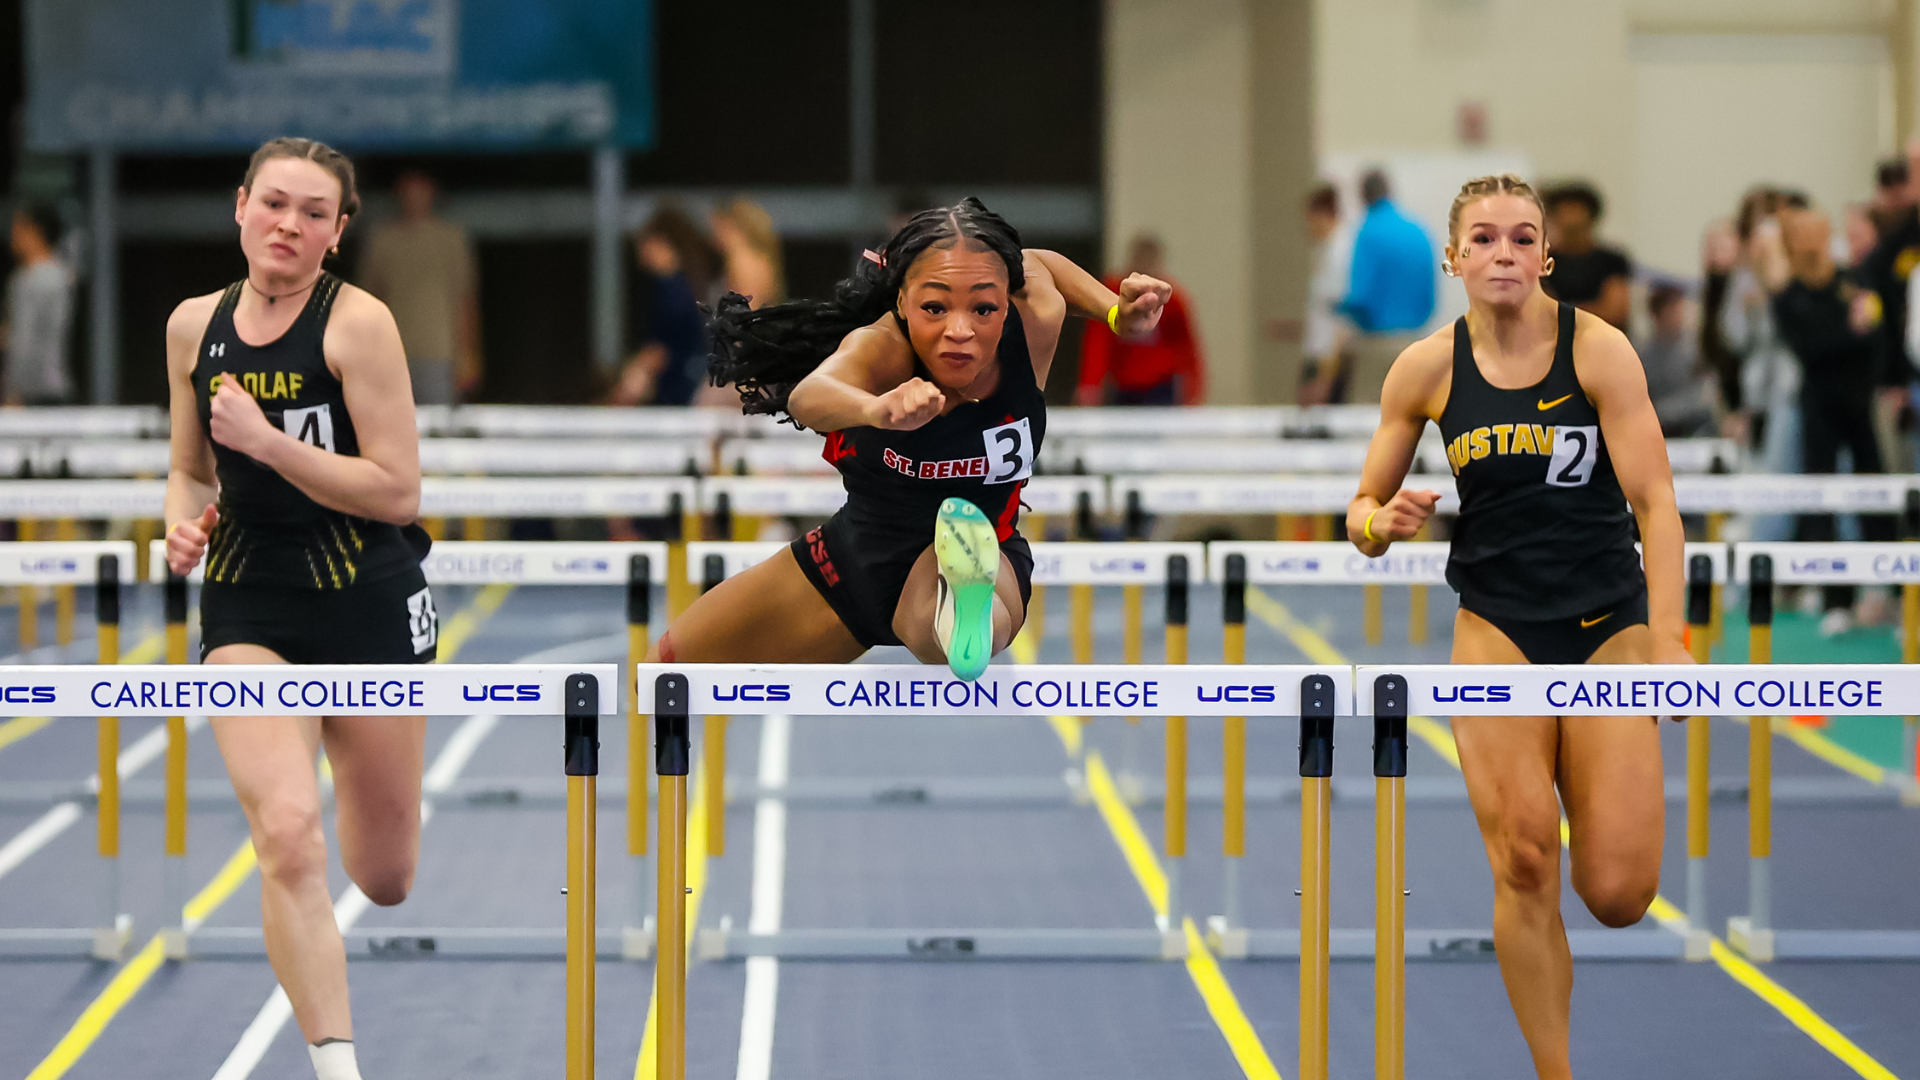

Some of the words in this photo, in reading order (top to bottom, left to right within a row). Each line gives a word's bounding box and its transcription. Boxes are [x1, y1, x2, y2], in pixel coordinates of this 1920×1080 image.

[209, 372, 238, 403] S
[242, 371, 304, 399] OLAF
[298, 411, 326, 450] 4
[883, 447, 915, 476] ST.
[994, 428, 1023, 482] 3
[1556, 430, 1587, 482] 2
[0, 686, 56, 703] CS
[91, 681, 263, 708] CARLETON
[278, 681, 423, 707] COLLEGE
[463, 684, 541, 702] UCS
[713, 684, 791, 702] UCS
[825, 681, 997, 708] CARLETON
[1012, 681, 1157, 707] COLLEGE
[1198, 685, 1275, 702] UCS
[1433, 685, 1512, 702] UCS
[1546, 681, 1719, 707] CARLETON
[1734, 681, 1882, 707] COLLEGE
